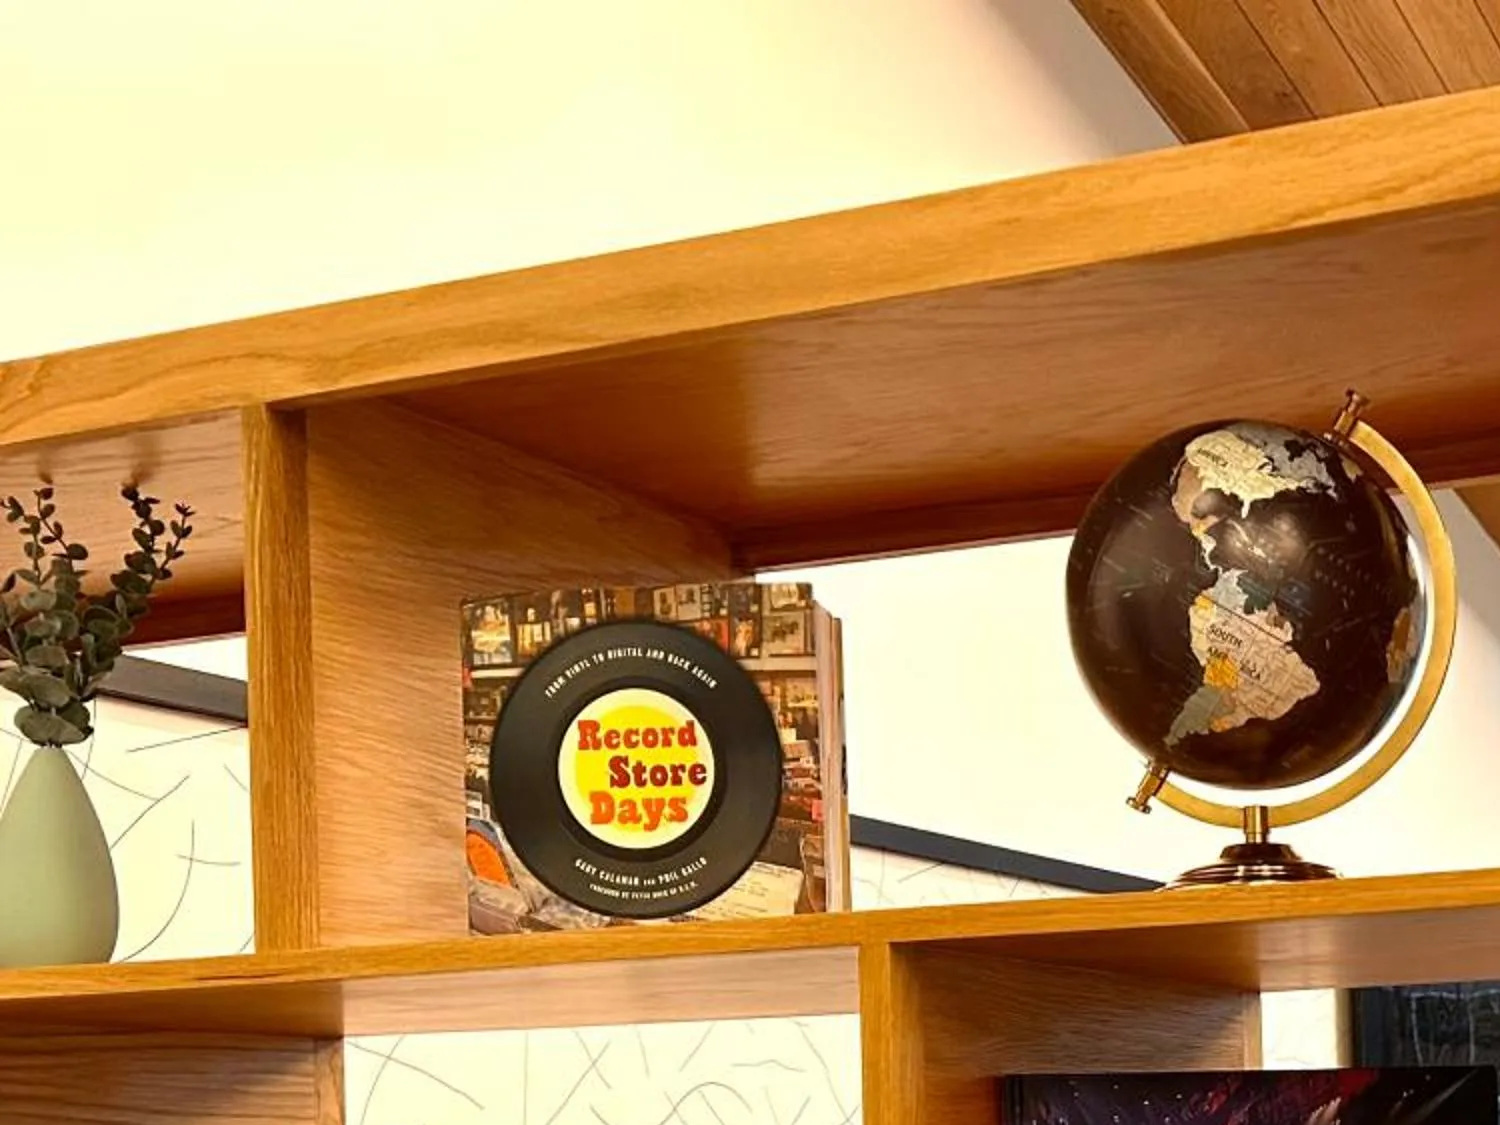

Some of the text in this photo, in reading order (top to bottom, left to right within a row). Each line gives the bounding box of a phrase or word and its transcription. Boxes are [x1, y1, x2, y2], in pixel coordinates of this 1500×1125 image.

[578, 720, 697, 750] Record
[609, 756, 707, 788] Store
[589, 791, 689, 832] Days
